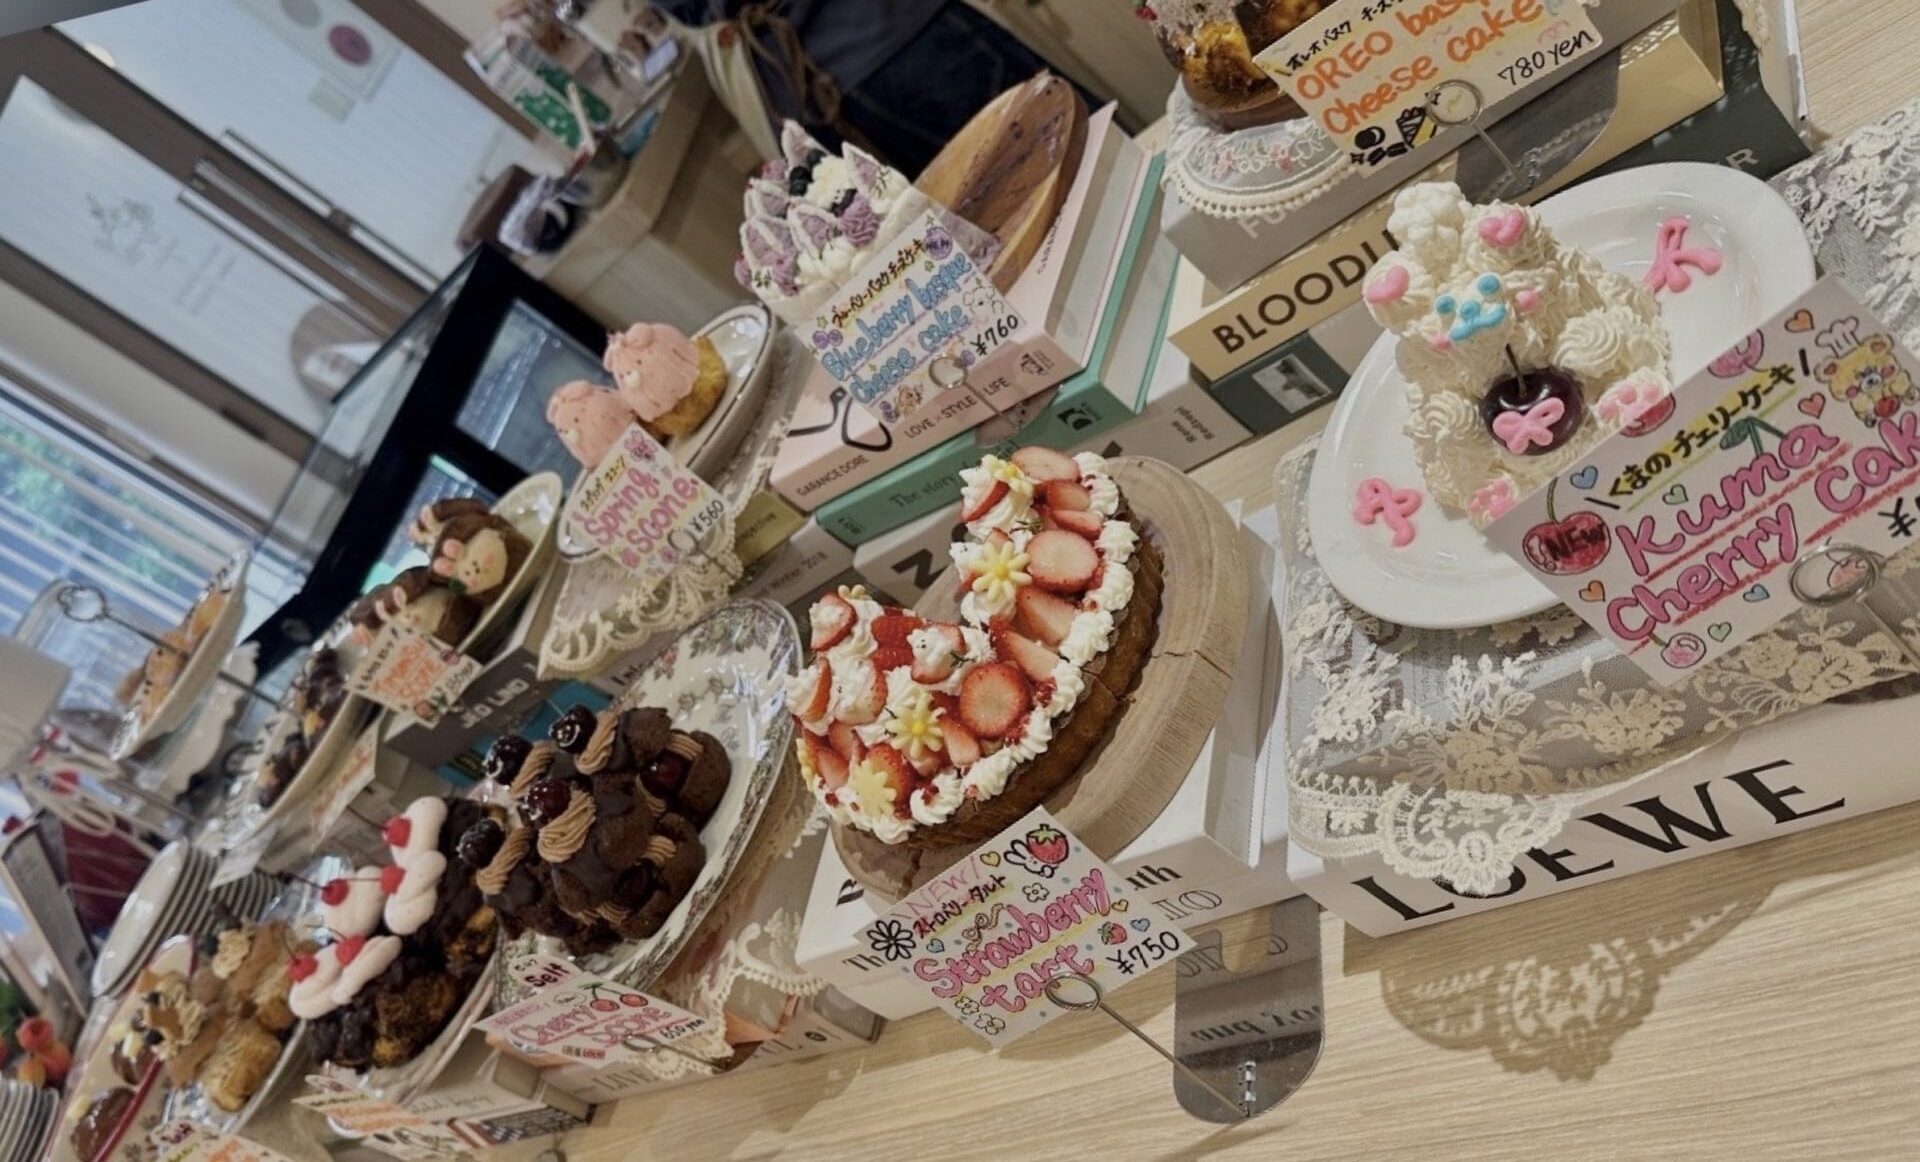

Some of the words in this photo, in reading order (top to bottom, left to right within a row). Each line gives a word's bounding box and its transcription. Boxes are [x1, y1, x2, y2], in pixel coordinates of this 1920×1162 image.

[1296, 30, 1394, 101] OREO
[1395, 0, 1491, 38] bas
[822, 294, 917, 383] Blueberry
[905, 252, 973, 312] basque
[969, 314, 1019, 357] ¥760
[903, 416, 938, 440] LOVE
[941, 395, 977, 420] STYLE
[984, 377, 1010, 397] LIFE
[1608, 363, 1797, 498] くまのチェリーケーキ
[689, 500, 725, 533] ¥560
[1546, 522, 1608, 564] NEW
[1615, 424, 1840, 577] Kuma
[1606, 503, 1799, 641] Cherry
[914, 868, 1111, 999] Strawberry
[1105, 930, 1181, 976] ¥750
